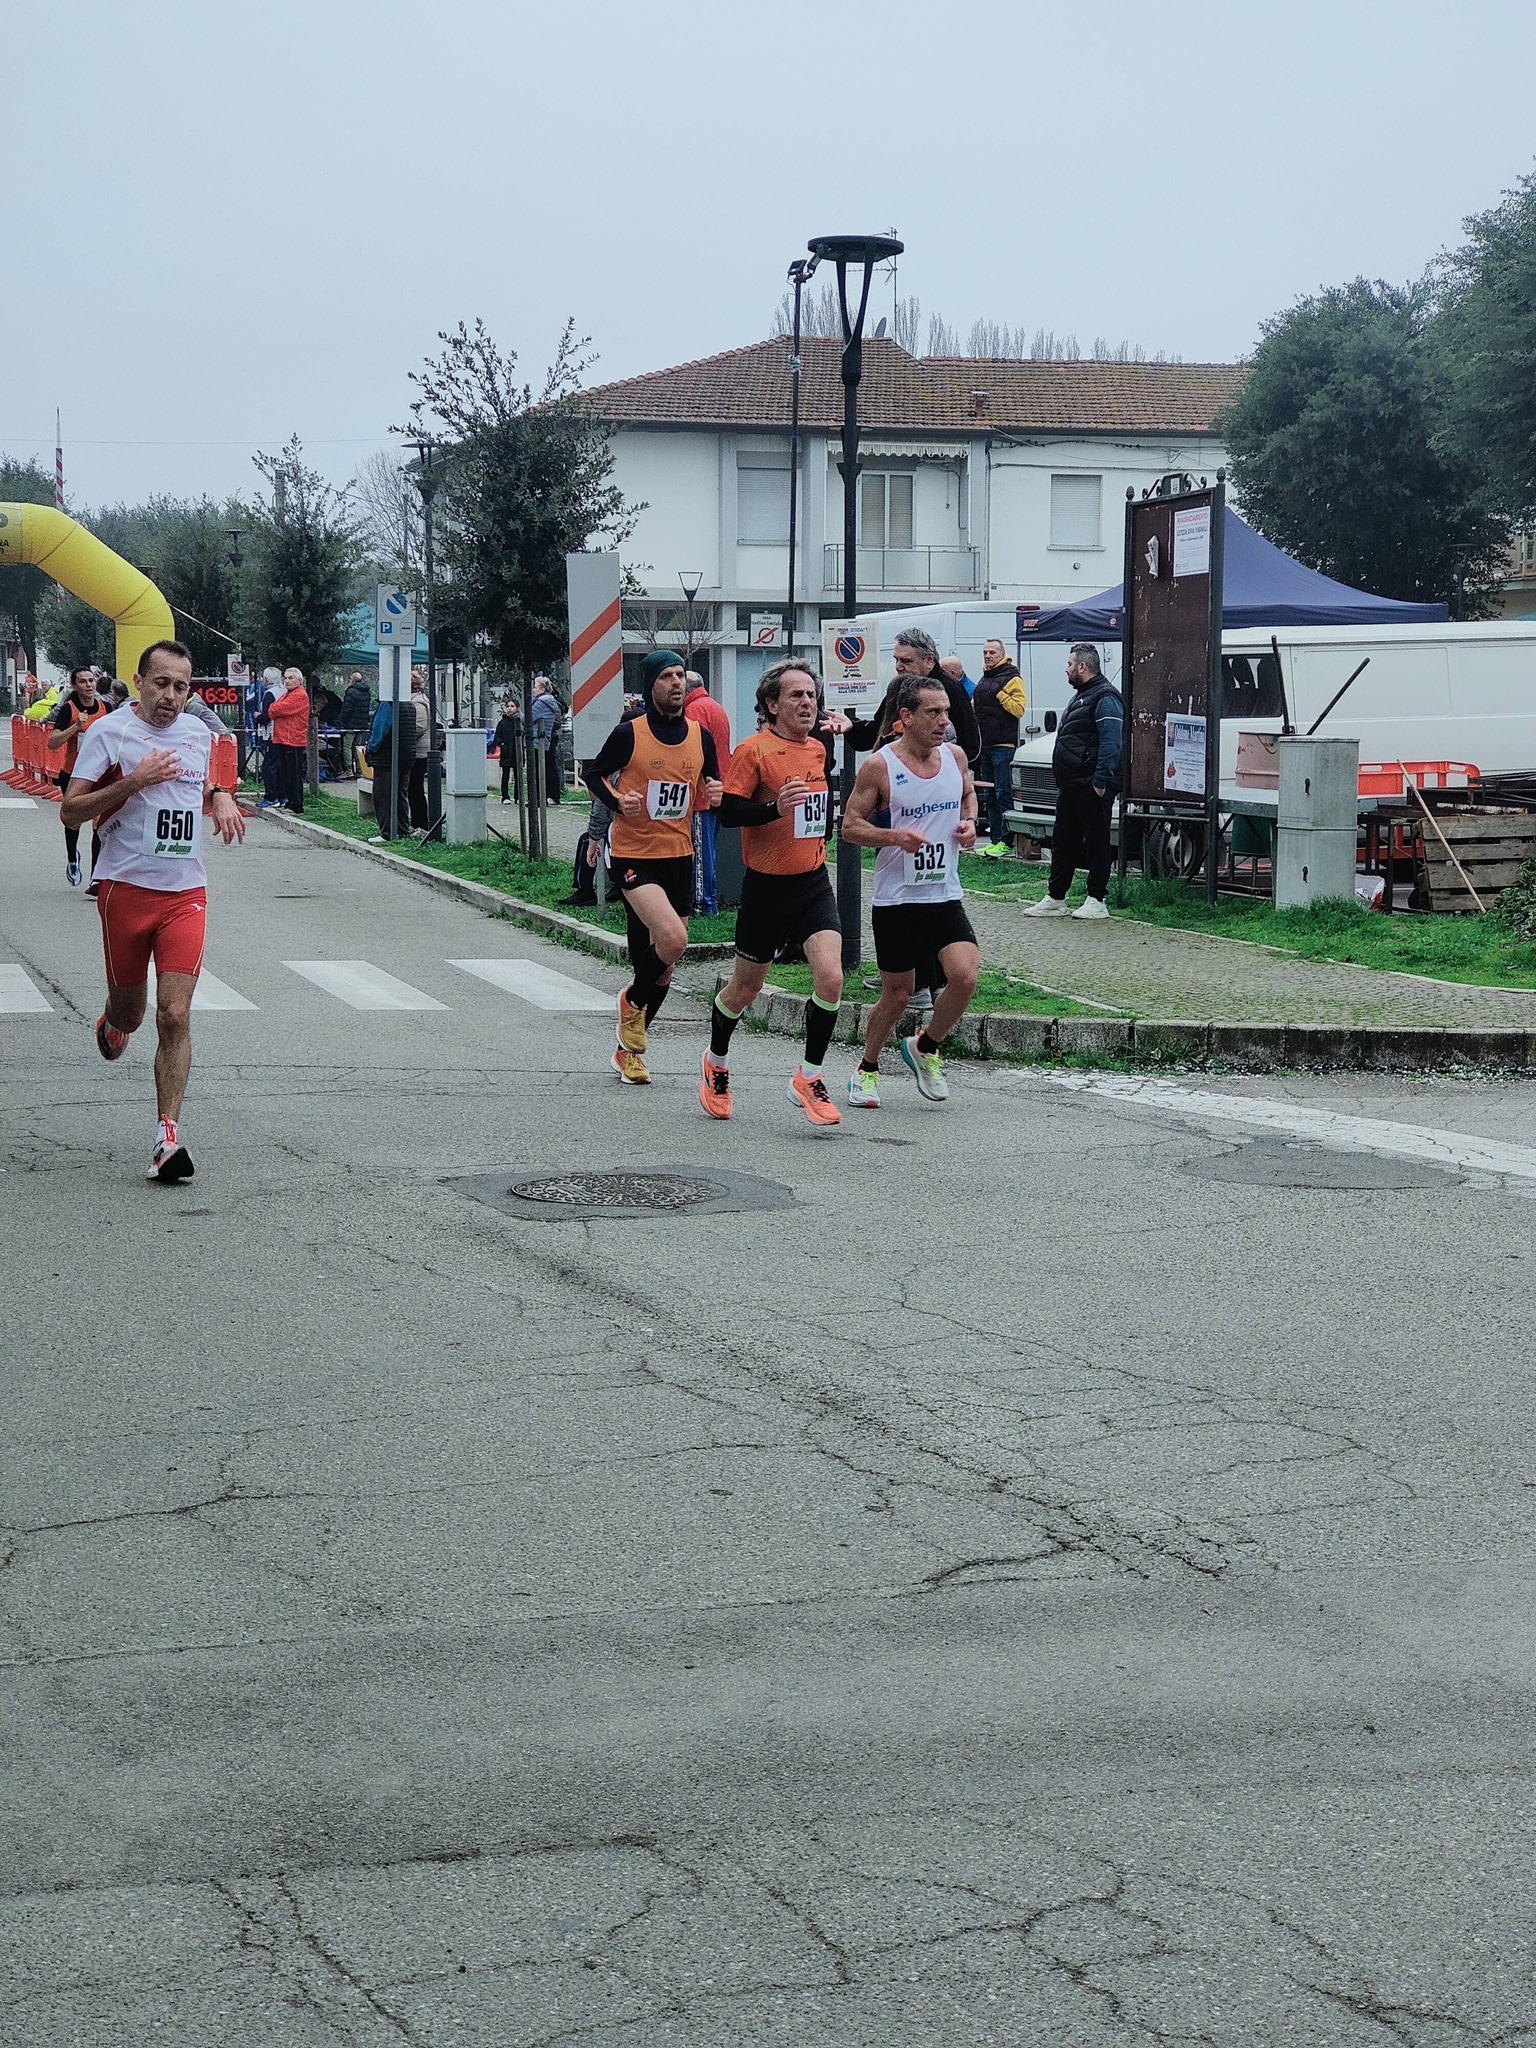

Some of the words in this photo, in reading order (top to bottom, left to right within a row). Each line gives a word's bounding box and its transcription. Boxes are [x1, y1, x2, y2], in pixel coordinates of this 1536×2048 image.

[382, 623, 390, 632] P
[659, 783, 688, 807] 541
[804, 793, 826, 822] 634
[901, 801, 959, 818] lughesina
[156, 809, 194, 841] 650
[914, 843, 946, 871] 532
